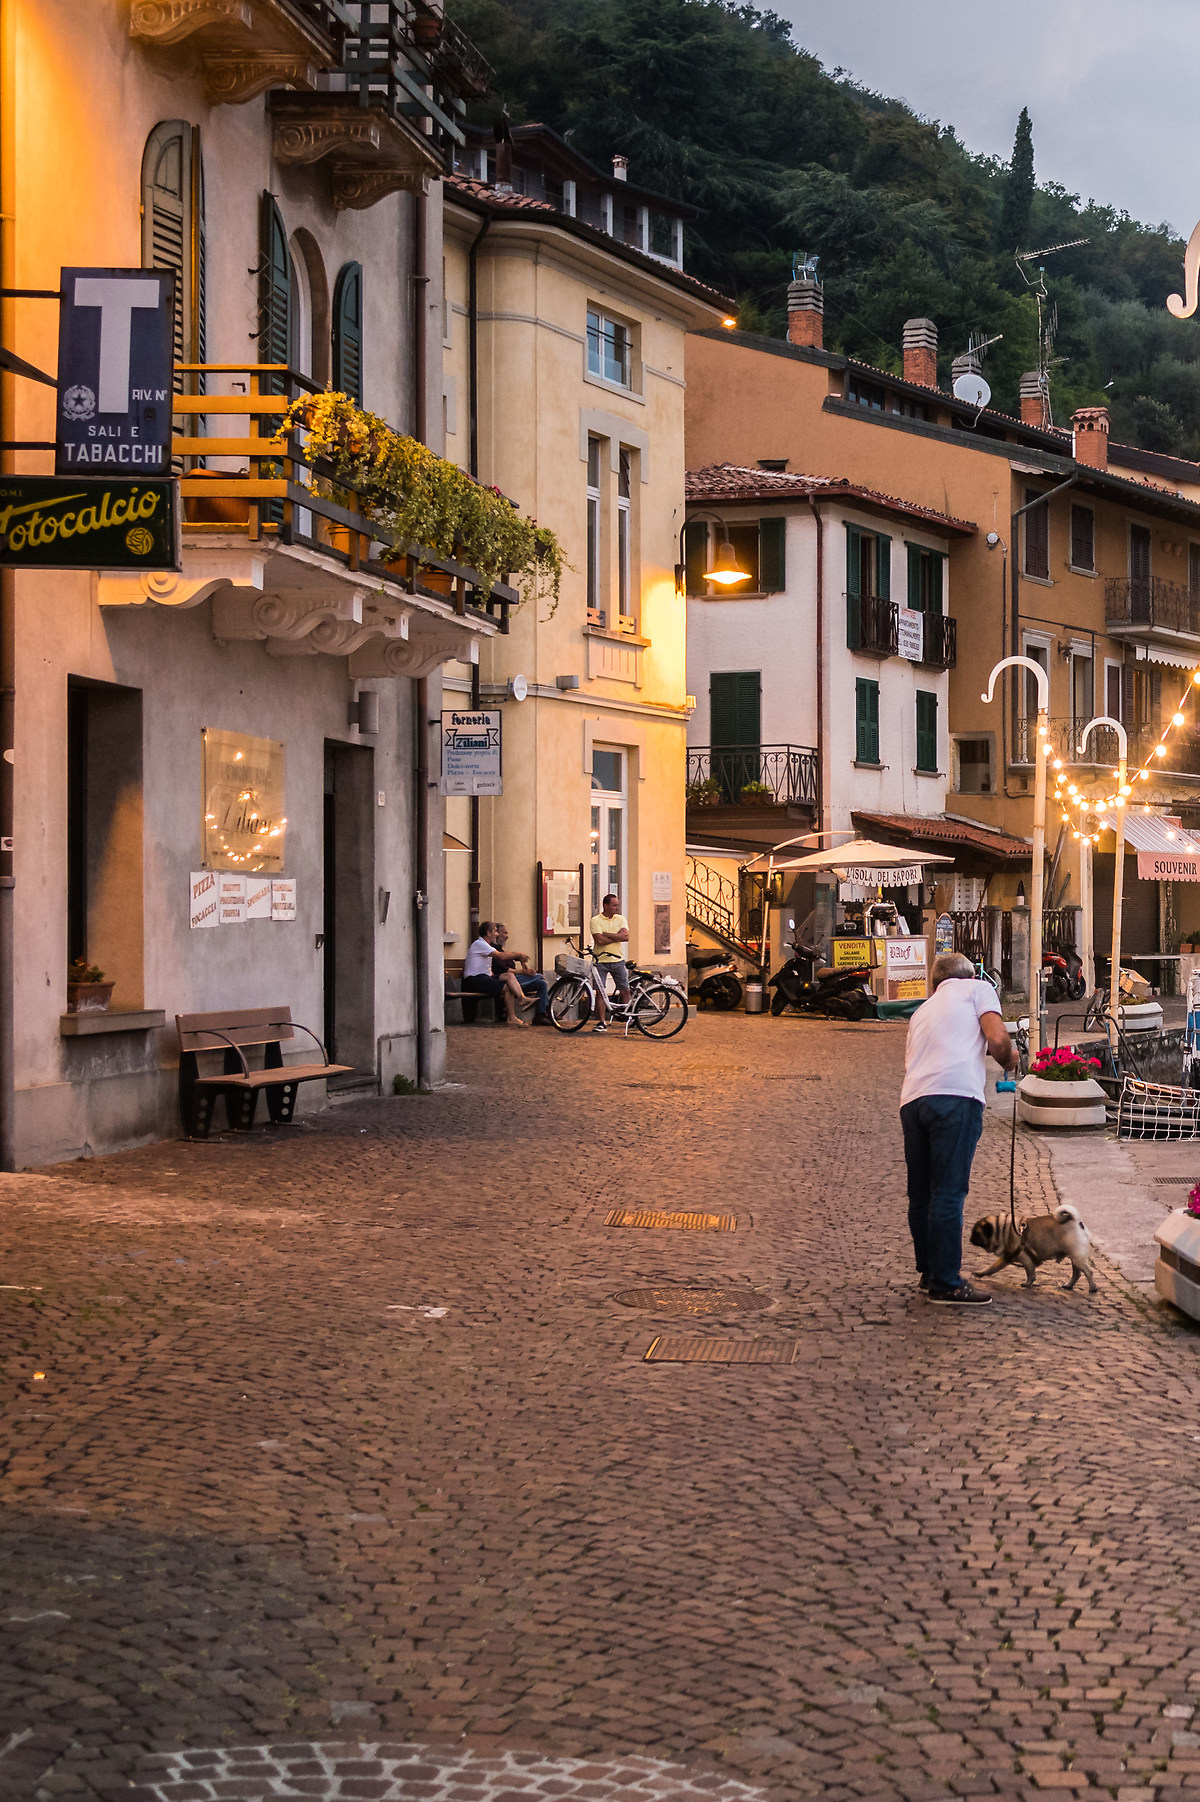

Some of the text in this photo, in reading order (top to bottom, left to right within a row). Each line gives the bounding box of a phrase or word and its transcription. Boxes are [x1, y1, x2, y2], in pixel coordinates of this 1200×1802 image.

[74, 278, 160, 413] T
[88, 425, 139, 438] SALI E
[65, 443, 163, 464] TABACCHI
[451, 713, 491, 725] forneria
[455, 737, 488, 748] Ziliani
[877, 871, 889, 882] DEI
[892, 867, 918, 882] SAPORI
[1154, 860, 1197, 875] SOUVENIR
[193, 872, 215, 899] PIZZA
